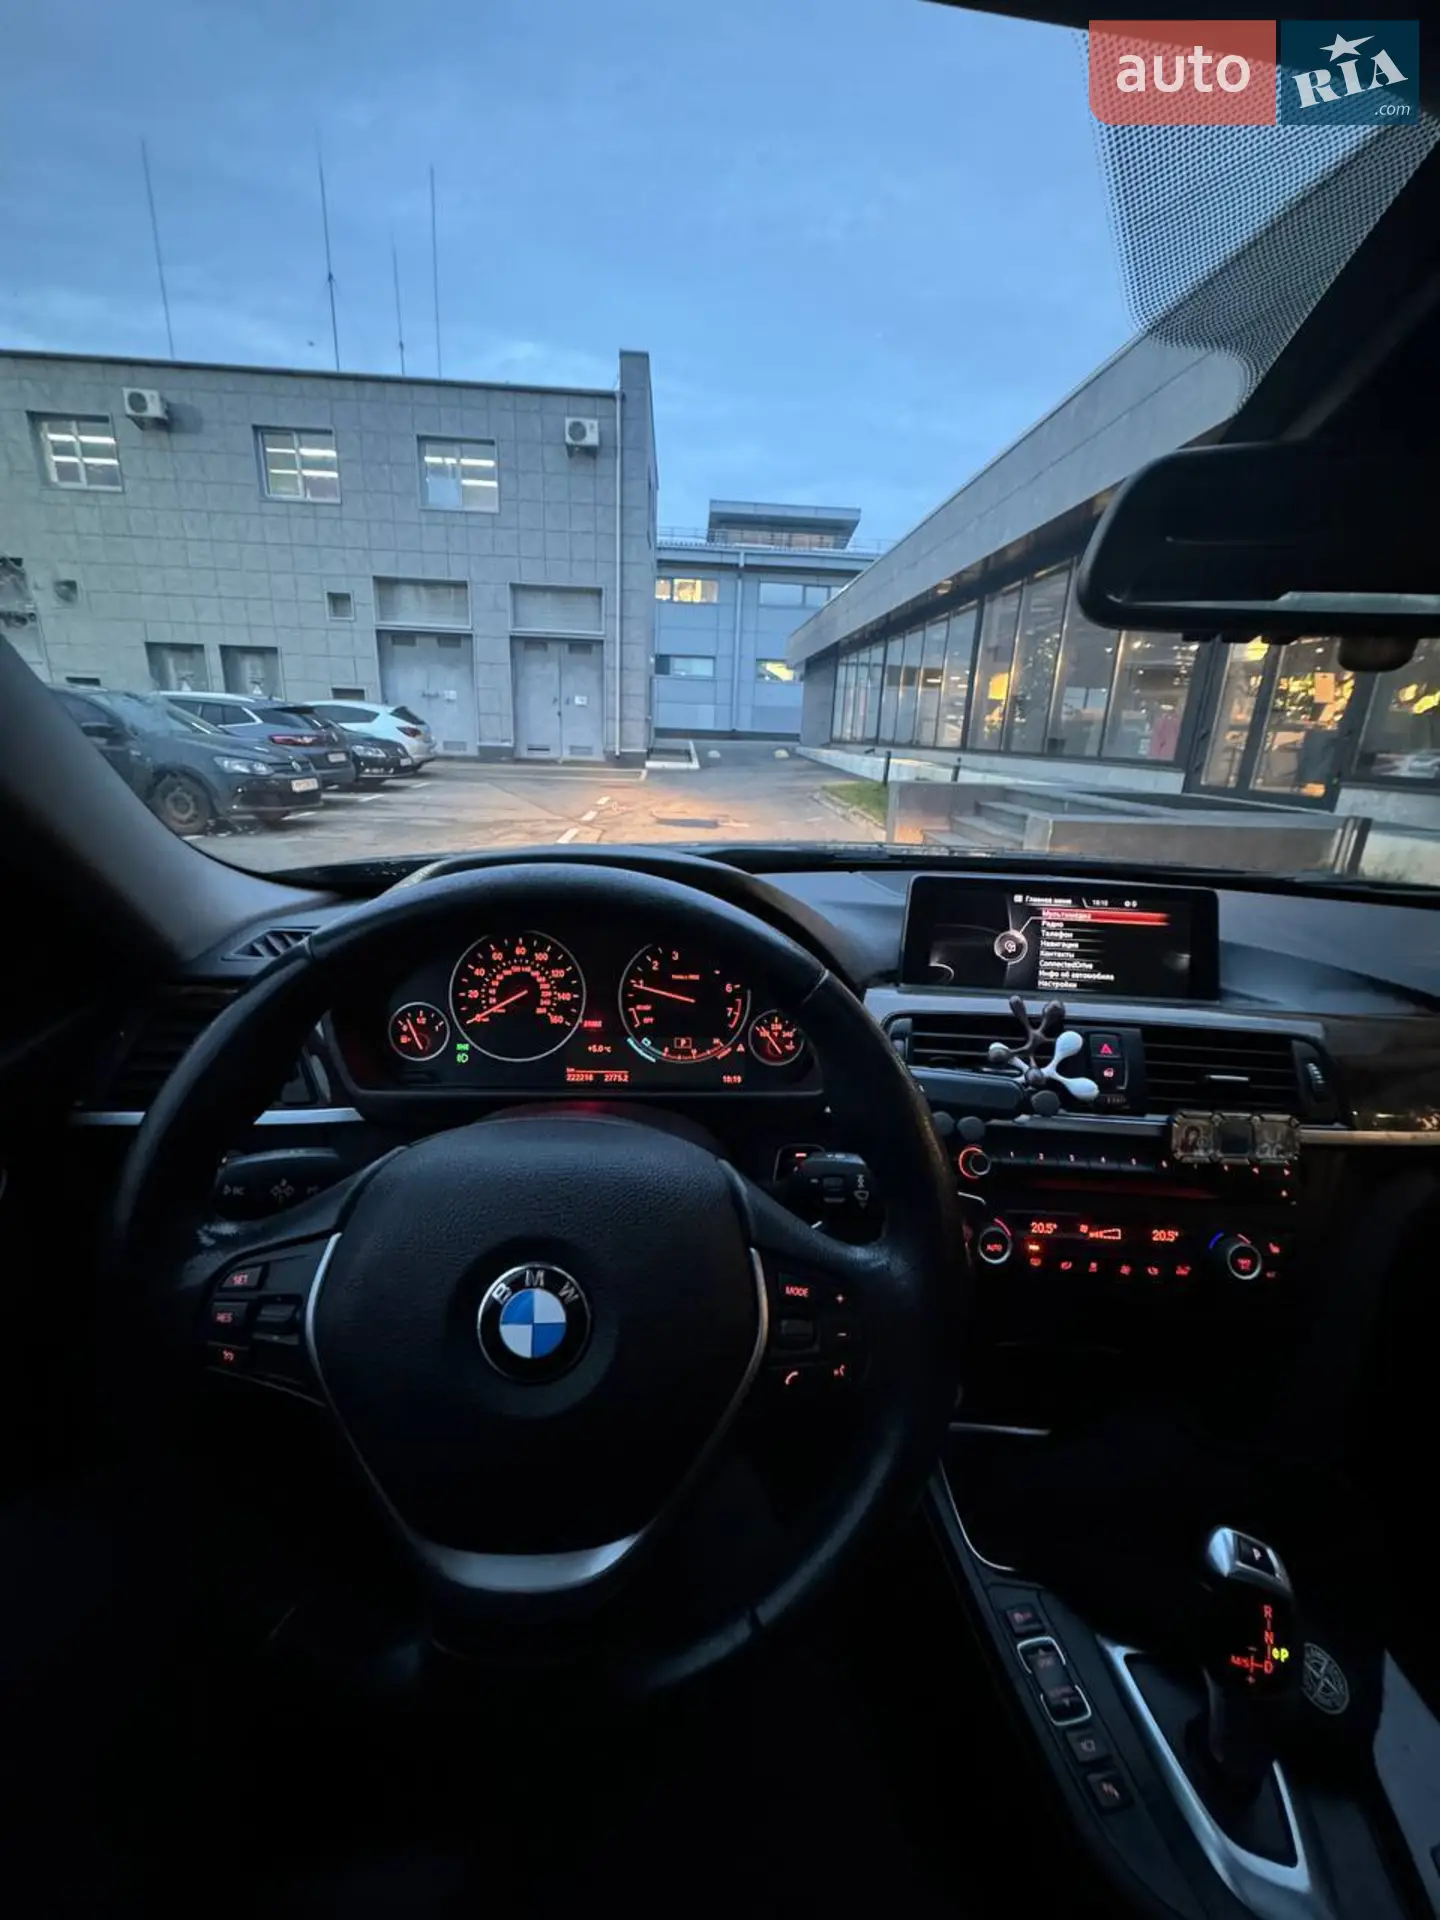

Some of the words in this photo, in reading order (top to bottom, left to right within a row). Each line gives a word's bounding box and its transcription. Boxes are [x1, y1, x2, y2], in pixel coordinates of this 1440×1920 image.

[1042, 920, 1064, 928] Радио
[1041, 930, 1073, 939] Телефон
[1040, 940, 1079, 949] Навигация
[534, 952, 548, 961] 100
[672, 951, 679, 961] 3
[1040, 951, 1075, 959] Контакты
[652, 960, 660, 971] 2
[1039, 960, 1094, 970] ConnectedDrive
[474, 968, 486, 977] 40
[551, 968, 565, 978] 120
[1038, 970, 1059, 978] Инфо
[725, 983, 733, 993] 6
[1038, 980, 1078, 990] Настройки
[468, 989, 479, 999] 20
[557, 992, 572, 1001] 140
[726, 1007, 733, 1017] 7
[680, 1039, 687, 1047] P
[232, 1273, 248, 1286] SET
[492, 1269, 579, 1306] BMW
[785, 1285, 809, 1298] MODE
[1252, 1547, 1262, 1561] P
[1264, 1604, 1273, 1619] R
[1264, 1630, 1274, 1645] N
[1280, 1647, 1289, 1663] P
[1264, 1659, 1273, 1674] D
